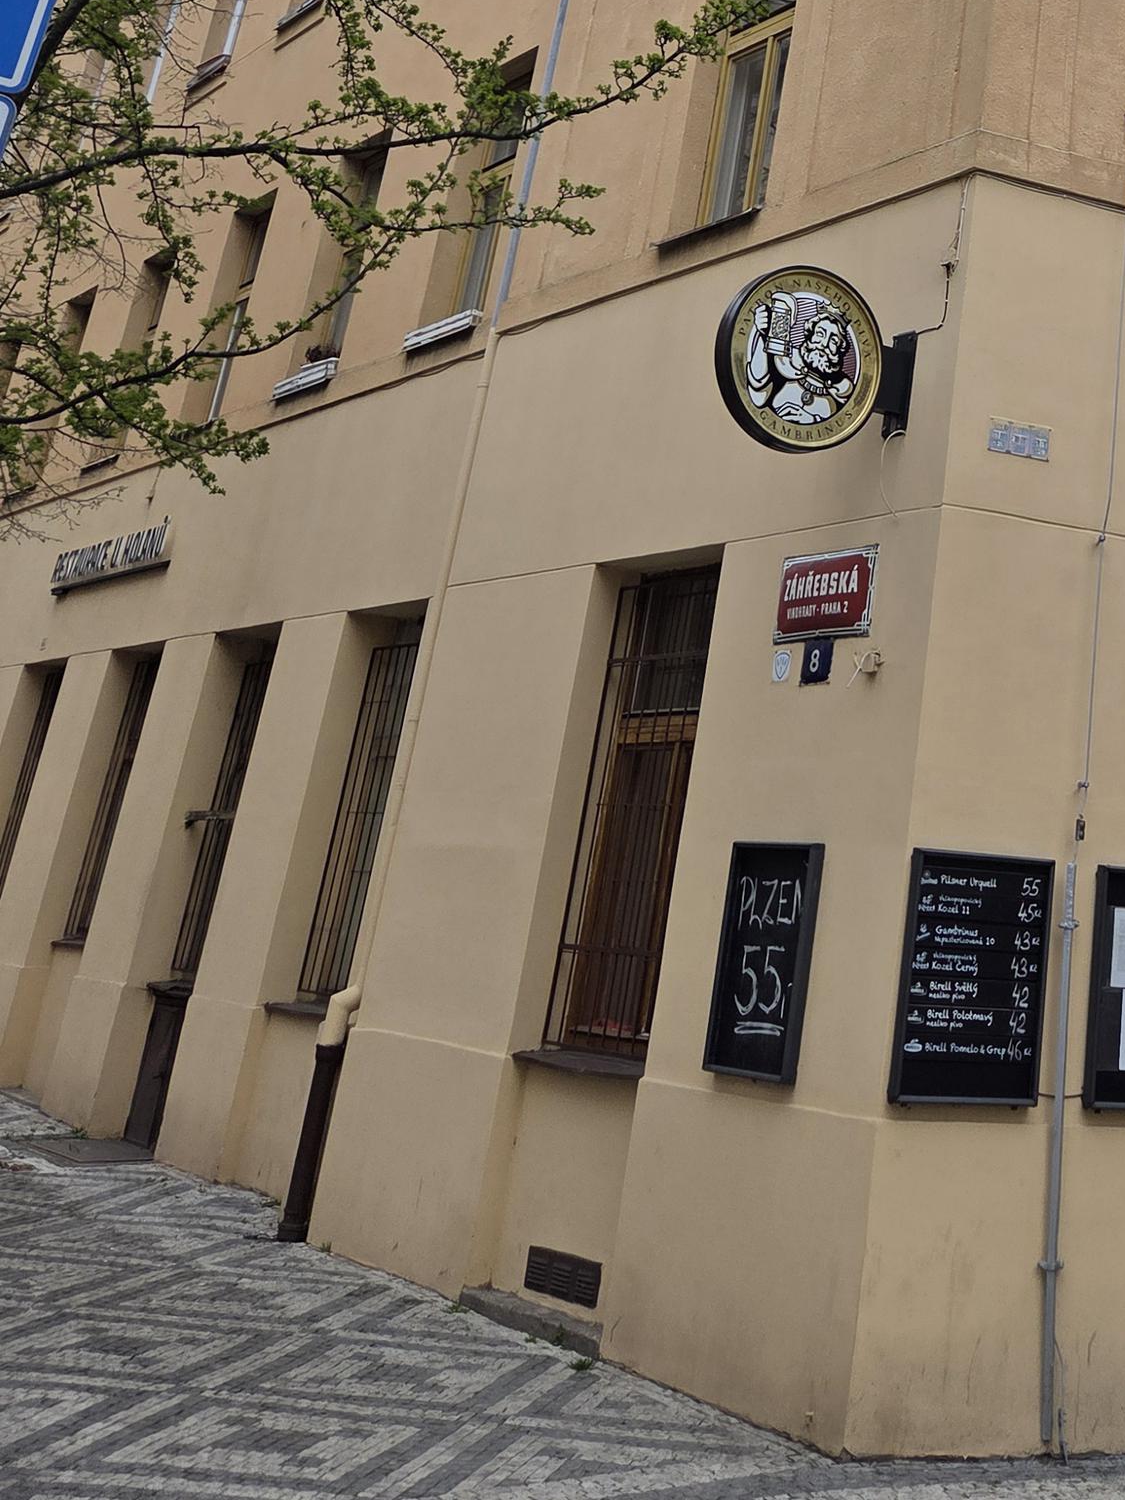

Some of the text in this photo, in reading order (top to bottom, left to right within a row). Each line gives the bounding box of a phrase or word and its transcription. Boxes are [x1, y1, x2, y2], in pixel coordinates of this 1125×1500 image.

[738, 283, 785, 337] PATRON
[852, 317, 874, 361] PIVA
[758, 409, 854, 442] GAMBRINUS
[110, 535, 124, 569] U
[784, 564, 859, 602] ZÁHŘEBSKÁ
[786, 604, 816, 619] VINOHRADY
[820, 601, 840, 615] PRAHA
[842, 600, 848, 612] 2
[809, 648, 820, 674] 8
[940, 874, 967, 886] Pilsner
[969, 877, 997, 891] Urquell
[1020, 877, 1041, 896] 55
[937, 904, 958, 914] Kozel
[961, 905, 970, 915] 11
[1017, 901, 1036, 922] 45
[935, 924, 978, 936] Gambrinus
[985, 936, 995, 946] 10
[1014, 930, 1030, 950] 43
[931, 960, 952, 971] Kozel
[955, 960, 978, 976] Černý
[1010, 955, 1028, 978] 43
[929, 980, 951, 991] Birell
[954, 981, 978, 997] Světlý
[1011, 982, 1030, 1008] 42
[926, 1008, 949, 1019] Birell
[1008, 1010, 1026, 1034] 42
[924, 1041, 947, 1052] Birell
[949, 1042, 979, 1054] Pomelo
[986, 1045, 1006, 1060] Grep
[1007, 1038, 1021, 1060] 46
